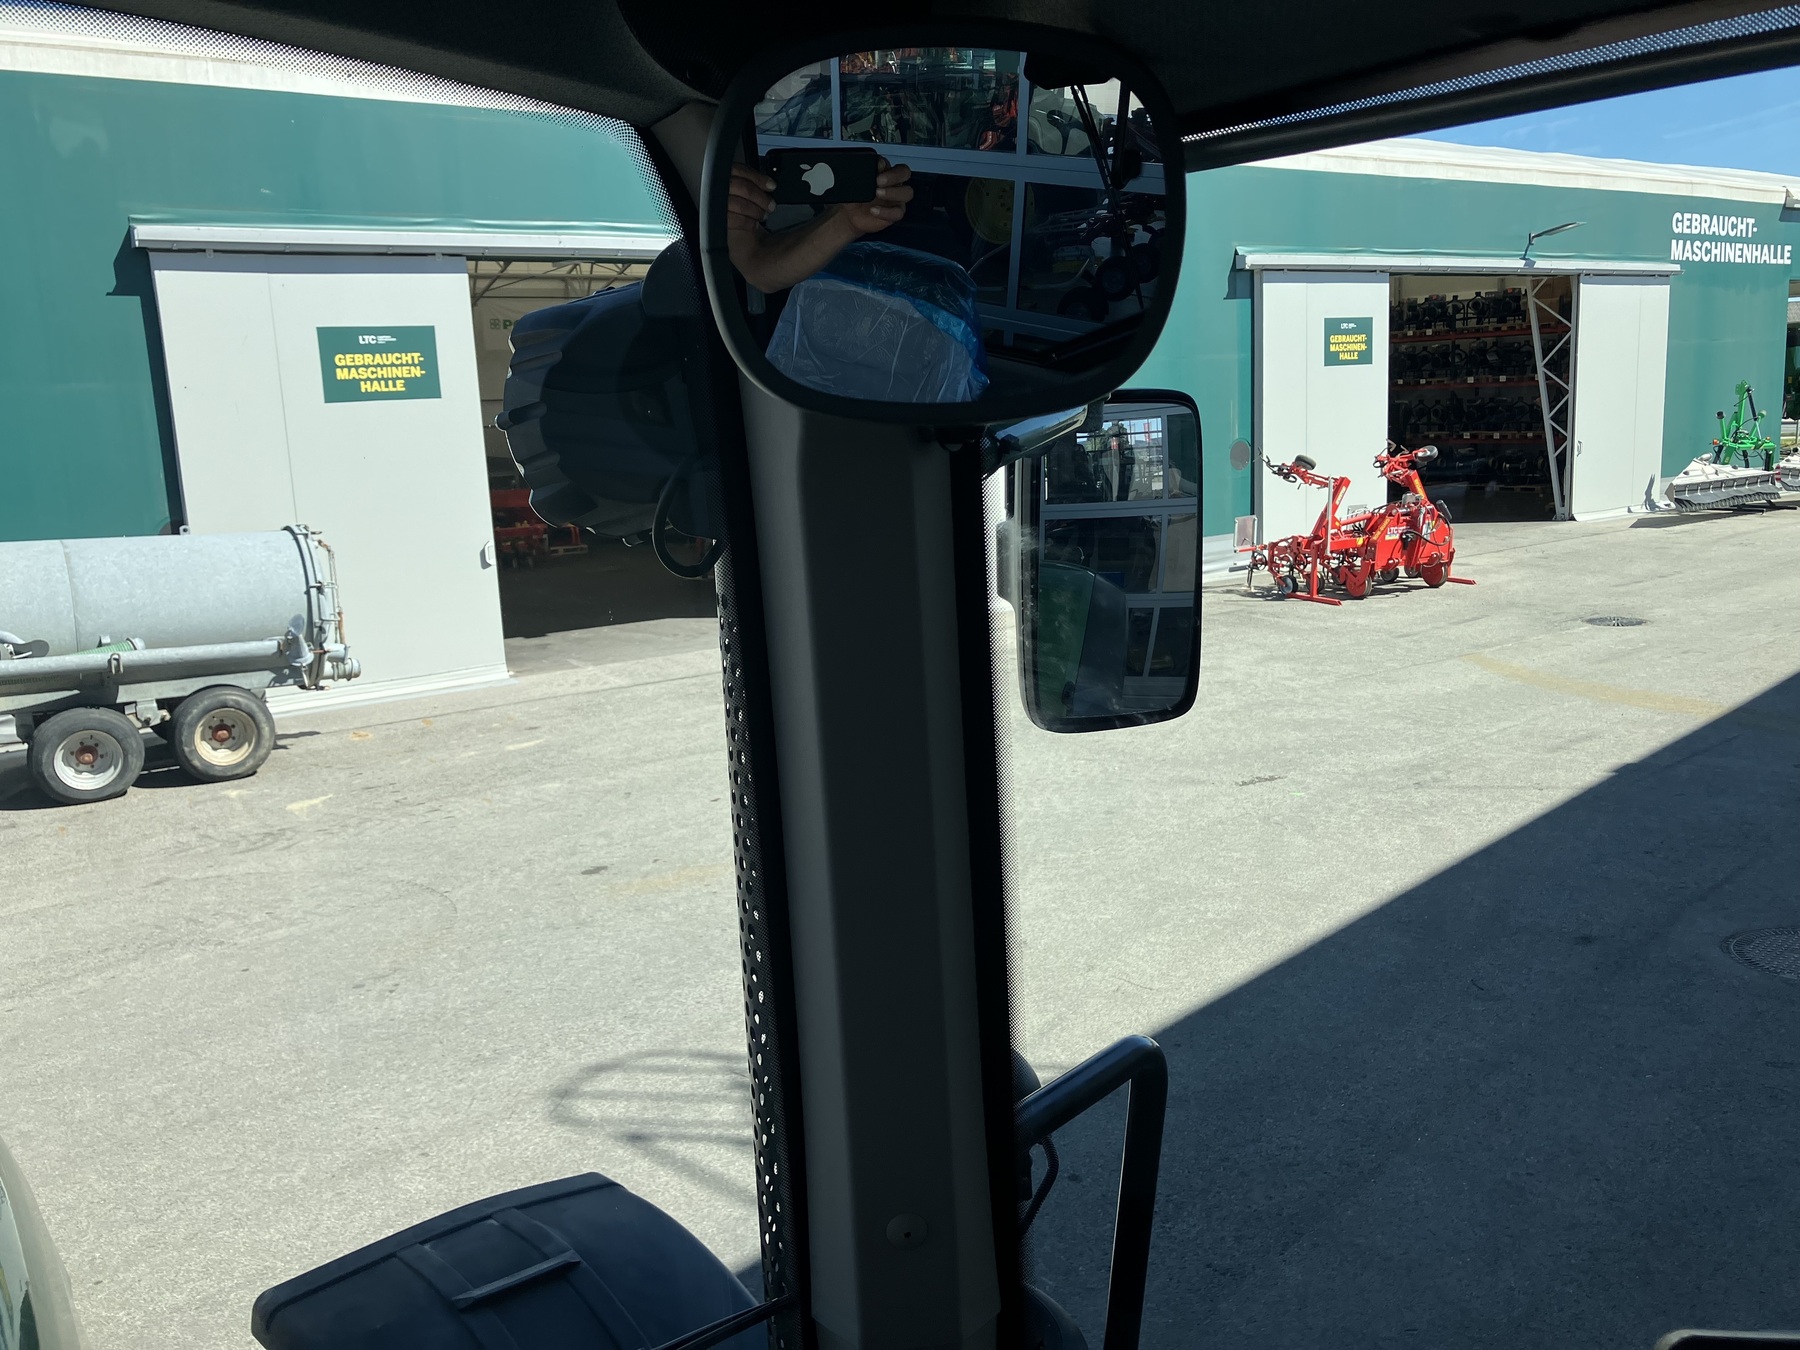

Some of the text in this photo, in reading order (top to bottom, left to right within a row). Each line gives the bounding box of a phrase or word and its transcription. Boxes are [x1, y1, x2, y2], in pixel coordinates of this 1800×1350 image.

[1672, 212, 1758, 238] GEBRAUCHT-
[1670, 239, 1792, 264] MASCHINENHALLE
[358, 335, 377, 344] LTC
[1329, 334, 1367, 343] GEBRAUCHT-
[1330, 343, 1367, 351] MASCHINEN-
[334, 352, 424, 366] GEBRAUCHT-
[1339, 351, 1359, 360] HALLE
[335, 366, 426, 380] MASCHINEN-
[360, 380, 406, 393] HALLE
